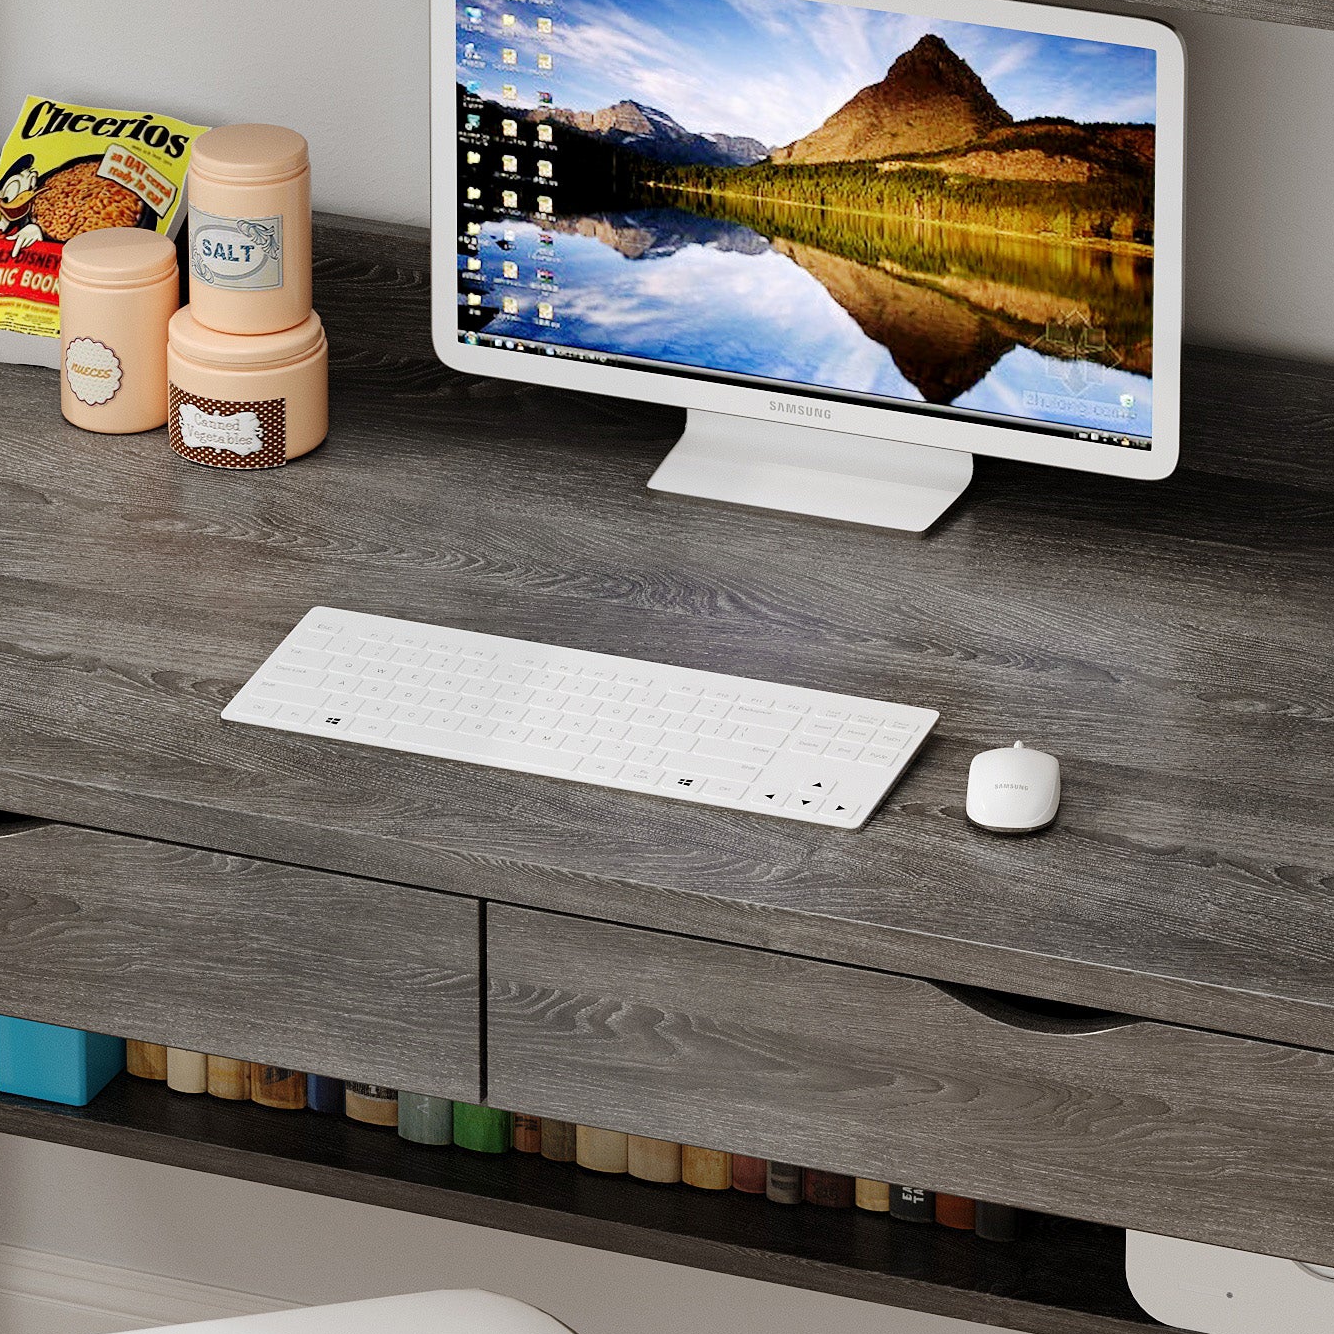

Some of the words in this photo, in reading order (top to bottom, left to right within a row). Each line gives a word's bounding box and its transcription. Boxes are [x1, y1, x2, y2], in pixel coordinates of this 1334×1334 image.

[21, 100, 190, 159] Cheerios
[124, 155, 148, 176] OAT
[202, 239, 255, 263] SALT
[769, 400, 832, 419] SAMSUNG
[194, 412, 241, 432] Canned
[186, 424, 253, 446] Vegetables
[995, 783, 1029, 791] SAMSUNG
